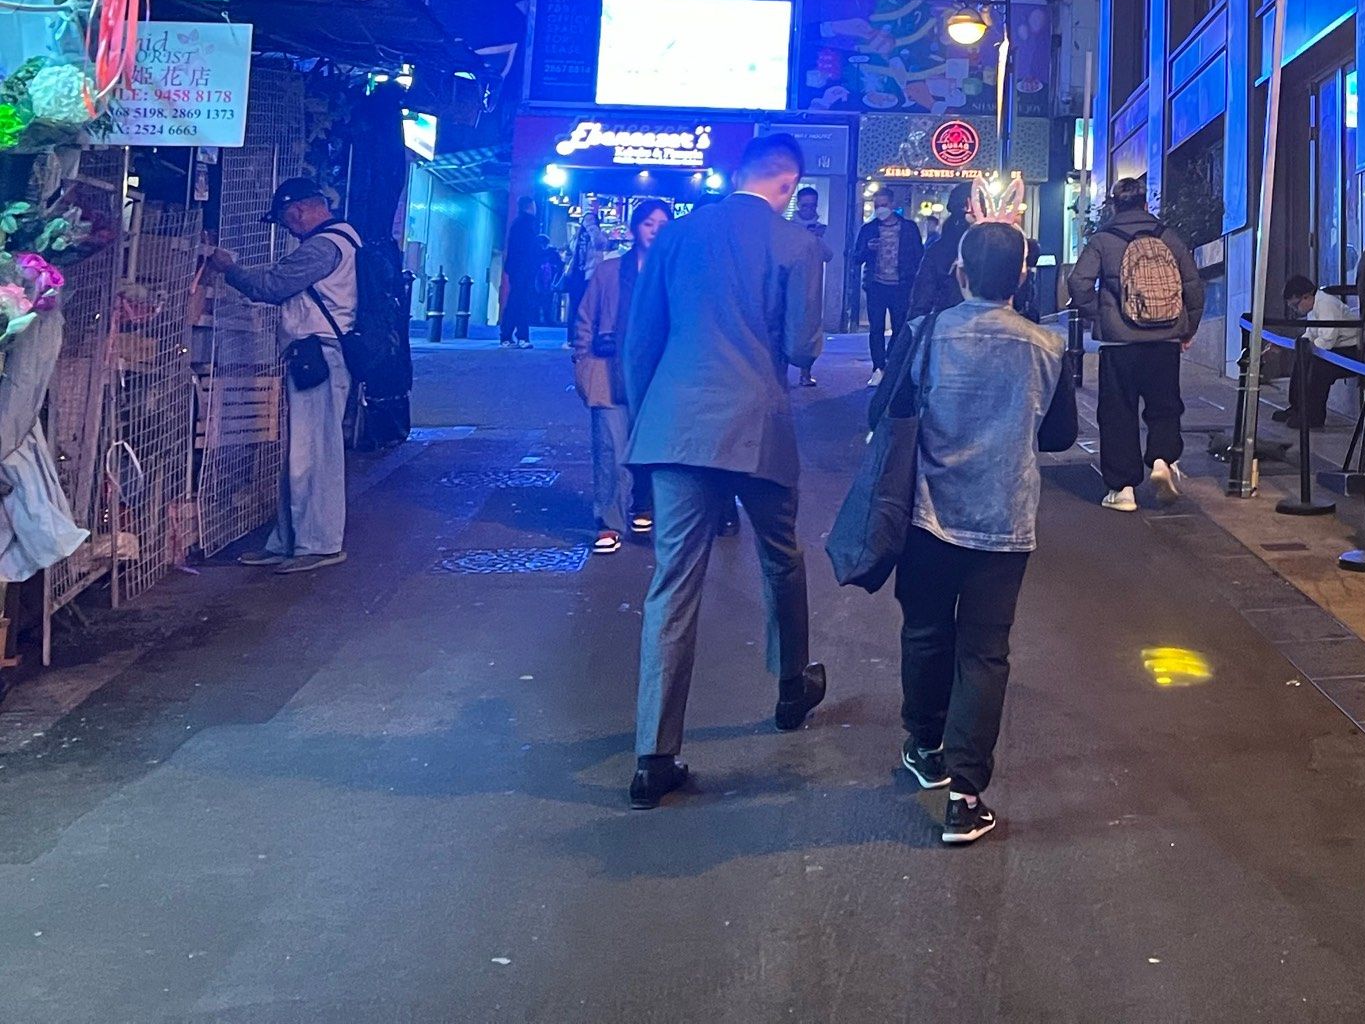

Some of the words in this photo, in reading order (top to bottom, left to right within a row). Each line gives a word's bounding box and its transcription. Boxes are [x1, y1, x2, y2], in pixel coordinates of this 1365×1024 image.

[136, 49, 197, 63] ORIST
[154, 89, 190, 102] 9458
[196, 90, 232, 103] 8178
[133, 107, 167, 120] 5198,
[172, 108, 201, 120] 2869
[206, 109, 235, 120] 1373
[135, 125, 164, 135] 2524
[168, 125, 198, 136] 6663
[961, 169, 983, 179] PIZZA
